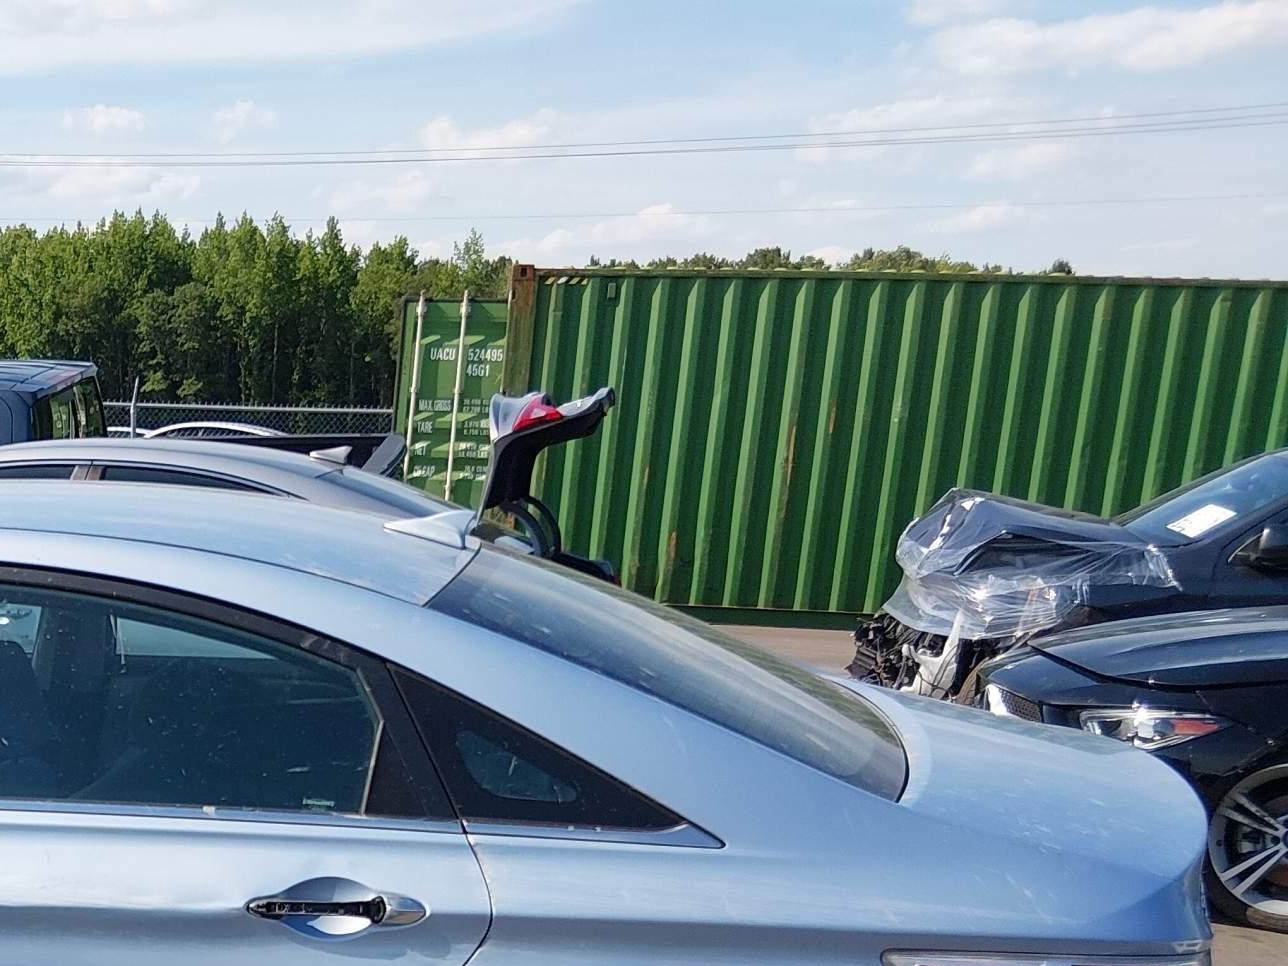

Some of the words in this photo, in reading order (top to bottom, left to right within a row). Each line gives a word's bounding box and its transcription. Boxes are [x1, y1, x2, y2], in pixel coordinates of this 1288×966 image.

[430, 348, 457, 360] UACU
[468, 348, 503, 361] 524495
[466, 363, 490, 377] 45G1
[417, 421, 432, 433] TARE
